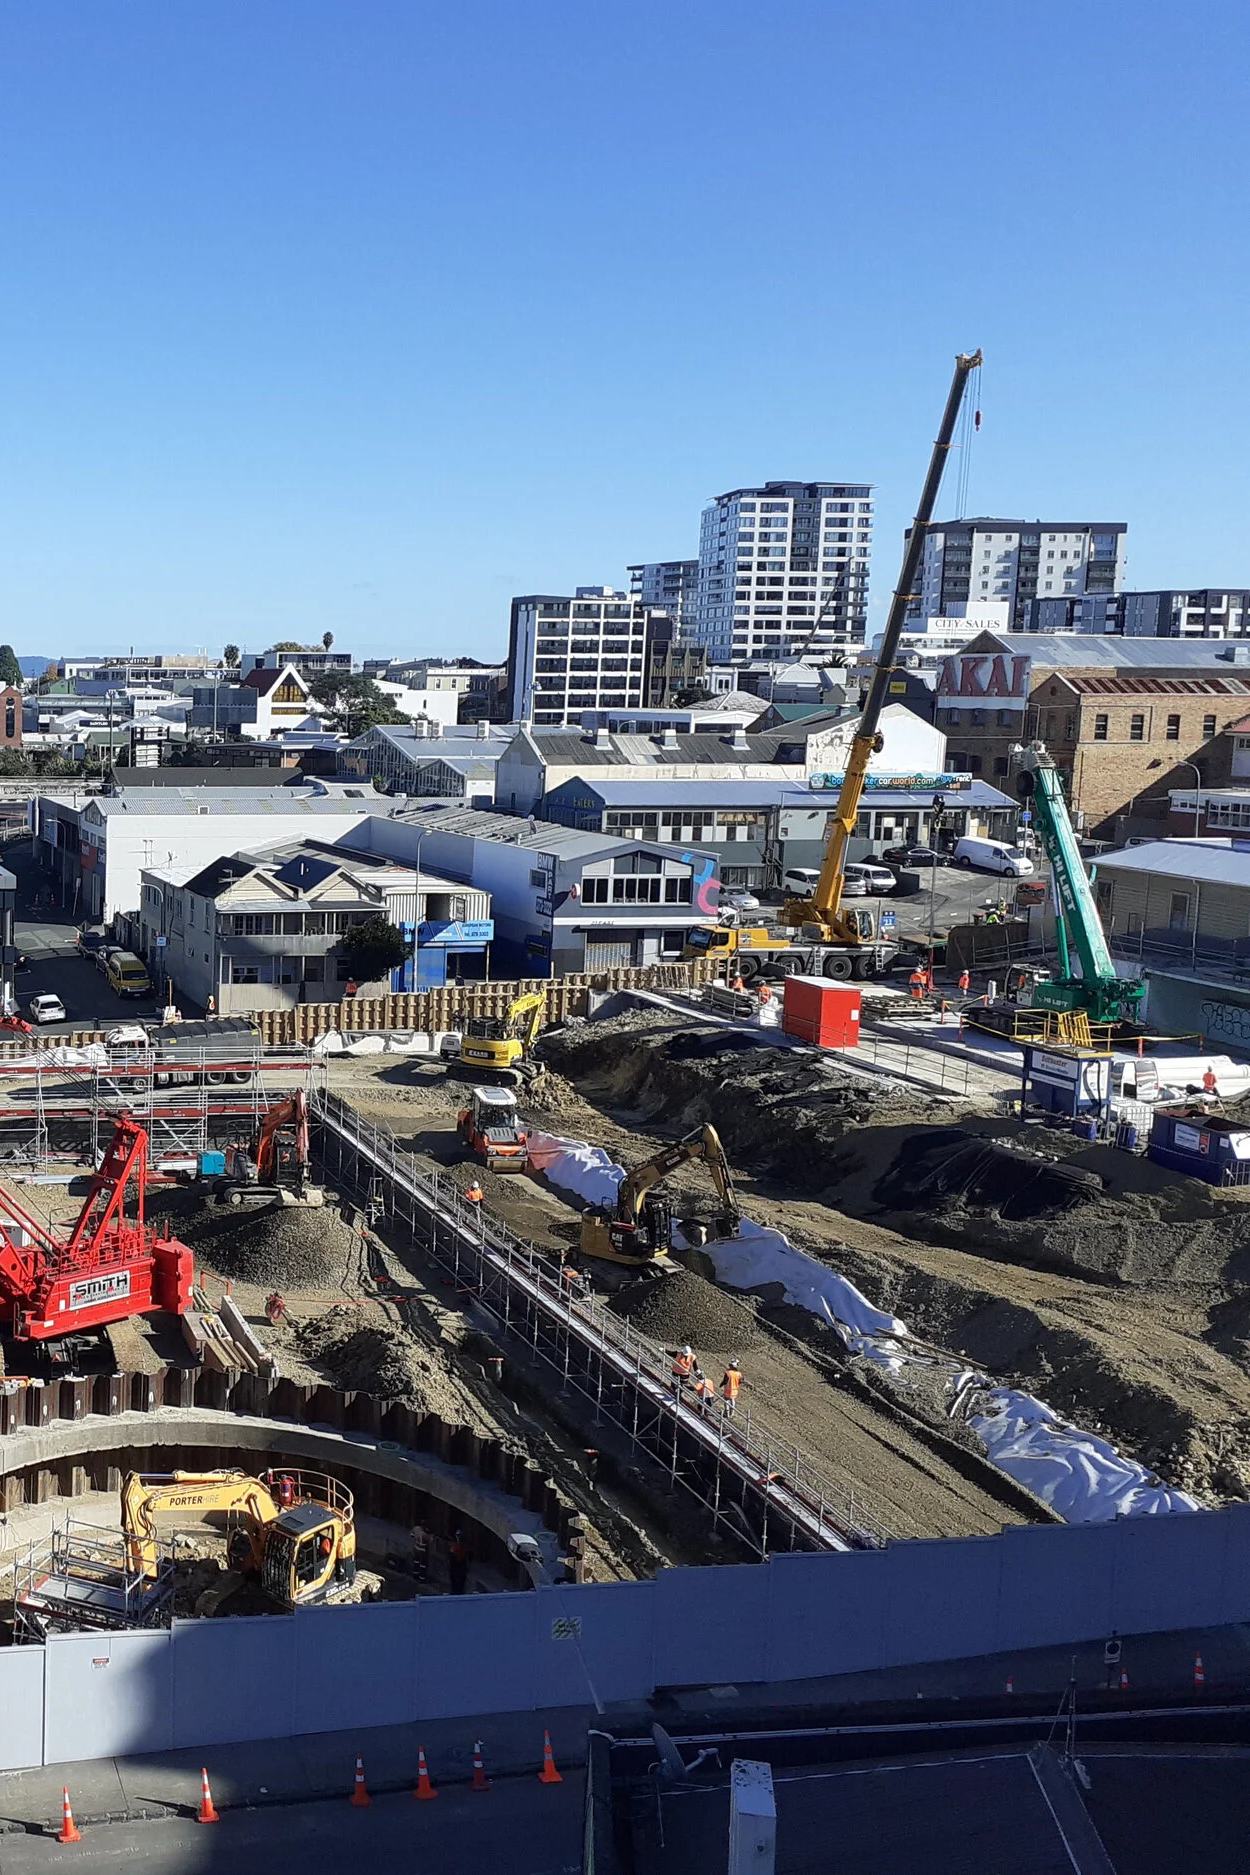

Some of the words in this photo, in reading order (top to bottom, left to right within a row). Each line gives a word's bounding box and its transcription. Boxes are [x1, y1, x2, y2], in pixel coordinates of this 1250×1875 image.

[935, 619, 961, 628] CITY
[965, 619, 1001, 629] SALES
[937, 655, 1031, 697] AKAI
[538, 853, 554, 871] BMW
[1058, 873, 1077, 912] LIFT
[611, 1232, 623, 1241] CAT
[72, 1273, 128, 1298] SMITH
